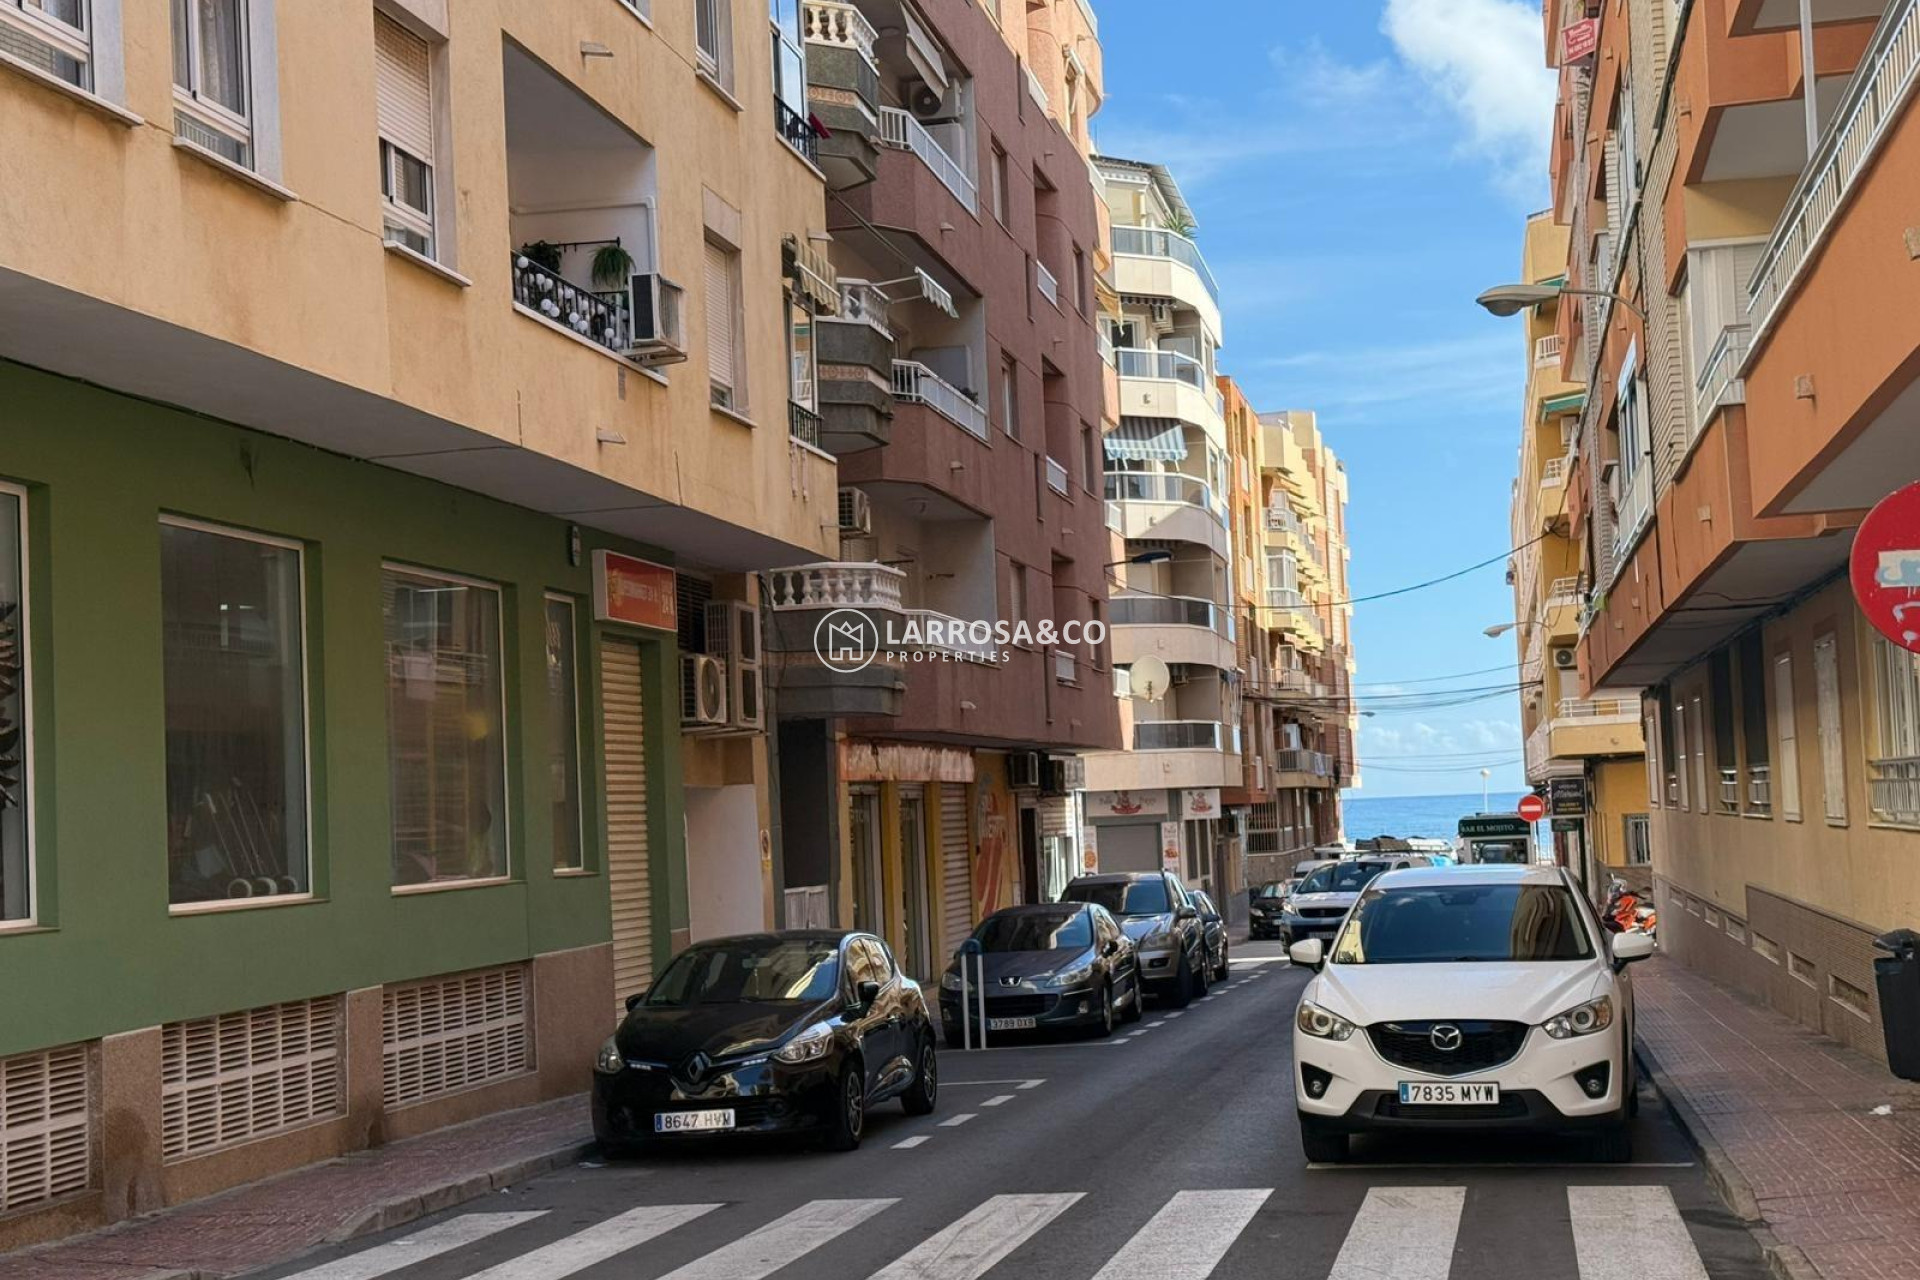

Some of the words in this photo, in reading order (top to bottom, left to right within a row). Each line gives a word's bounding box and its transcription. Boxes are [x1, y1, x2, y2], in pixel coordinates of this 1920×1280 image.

[1486, 824, 1514, 833] MOJITO
[1411, 1085, 1455, 1101] 7835
[1461, 1085, 1494, 1101] MYW
[664, 1113, 699, 1129] 8647
